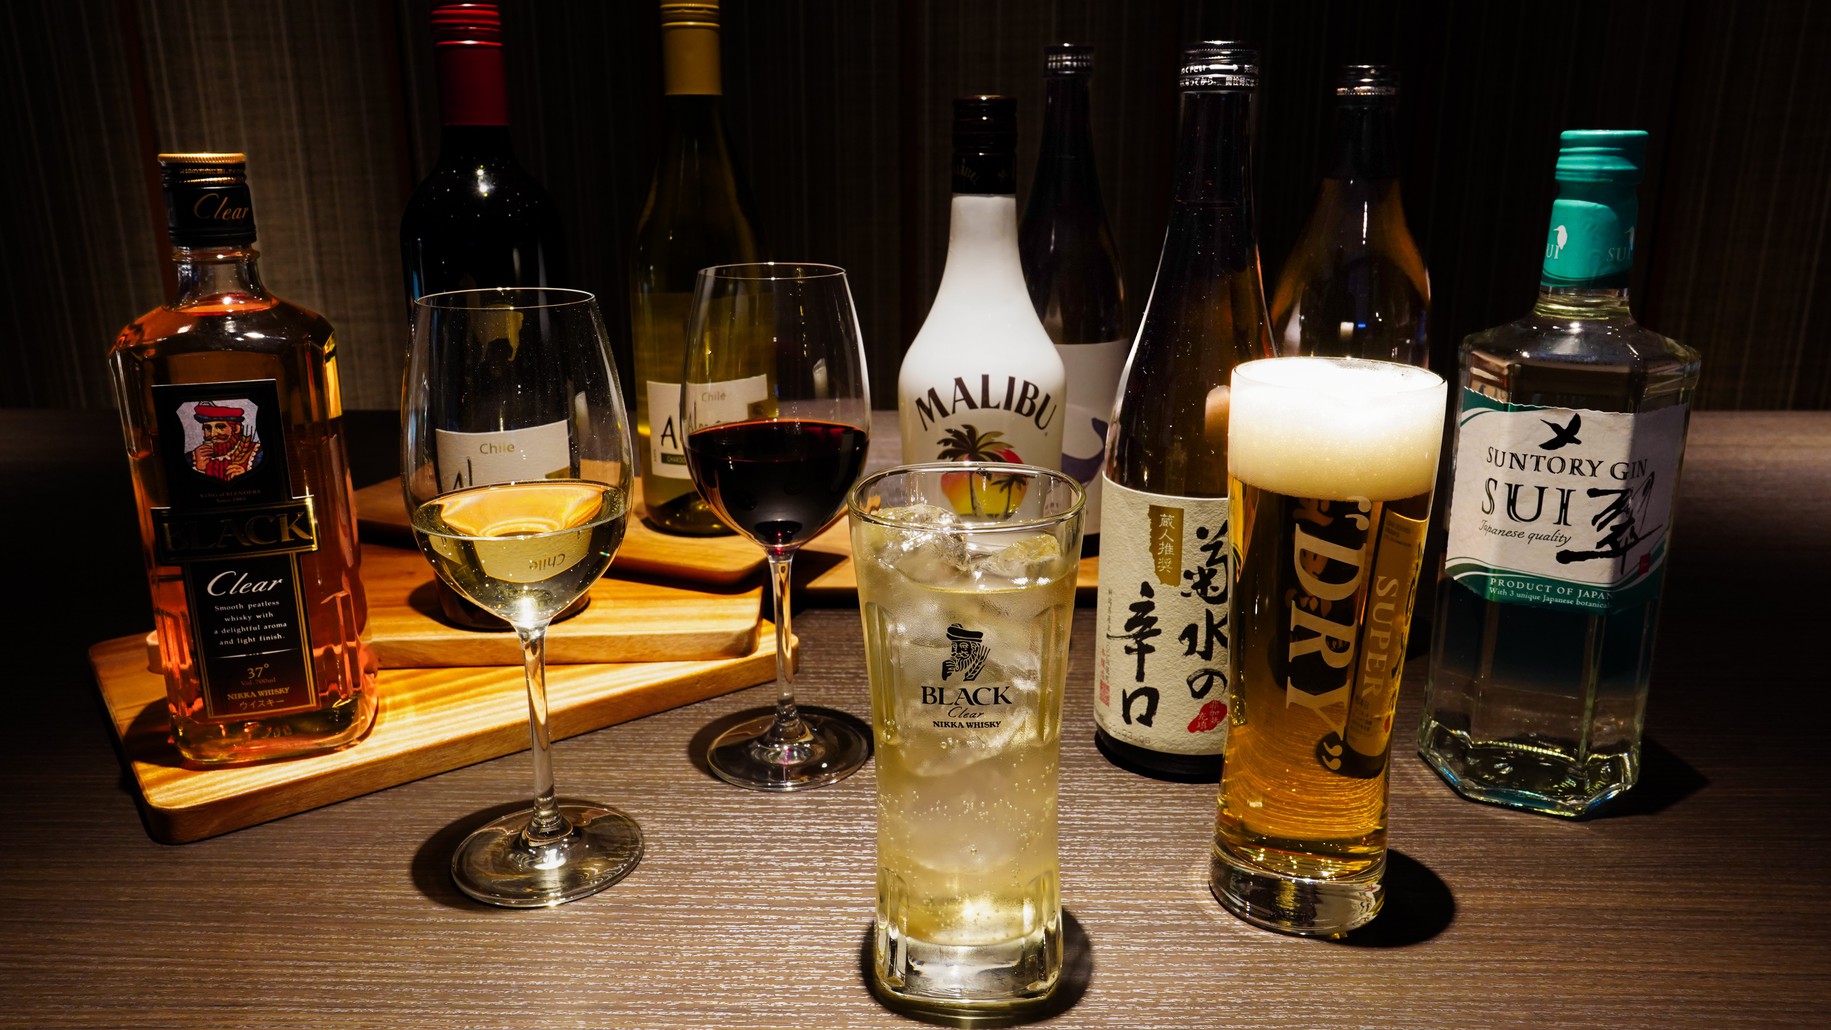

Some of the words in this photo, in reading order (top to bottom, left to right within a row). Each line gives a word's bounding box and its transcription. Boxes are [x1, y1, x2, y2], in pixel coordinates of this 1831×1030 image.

[193, 192, 249, 220] Clear
[915, 373, 1058, 432] MALIBU
[479, 442, 515, 455] Chile
[1486, 446, 1604, 479] SUNTORY
[1609, 458, 1648, 481] GIN
[1481, 477, 1577, 527] SUI
[1478, 519, 1525, 539] Japanese
[1527, 529, 1572, 548] quality
[206, 570, 283, 597] Clear
[1489, 577, 1552, 593] PRODUCT
[1556, 586, 1574, 596] OF
[1577, 588, 1614, 601] JAPAN
[214, 603, 245, 612] Smooth
[247, 600, 280, 611] peatless
[1489, 587, 1508, 596] With
[1516, 592, 1541, 602] unique
[1542, 594, 1574, 606] Japanese
[224, 613, 253, 624] whisky
[256, 611, 274, 620] with
[1179, 519, 1229, 699] 菊水の
[219, 638, 234, 646] and
[236, 635, 256, 646] light
[259, 633, 286, 643] finish.
[220, 623, 261, 635] delightful
[263, 622, 288, 630] aroma
[1361, 575, 1400, 698] SUPER
[1106, 581, 1162, 728] 辛口
[227, 691, 257, 701] NIKKA
[257, 686, 291, 697] WHISKY
[921, 685, 1013, 706] BLACK
[947, 706, 985, 719] Clear
[932, 720, 965, 729] NIKKA
[966, 720, 1002, 729] WHISKY
